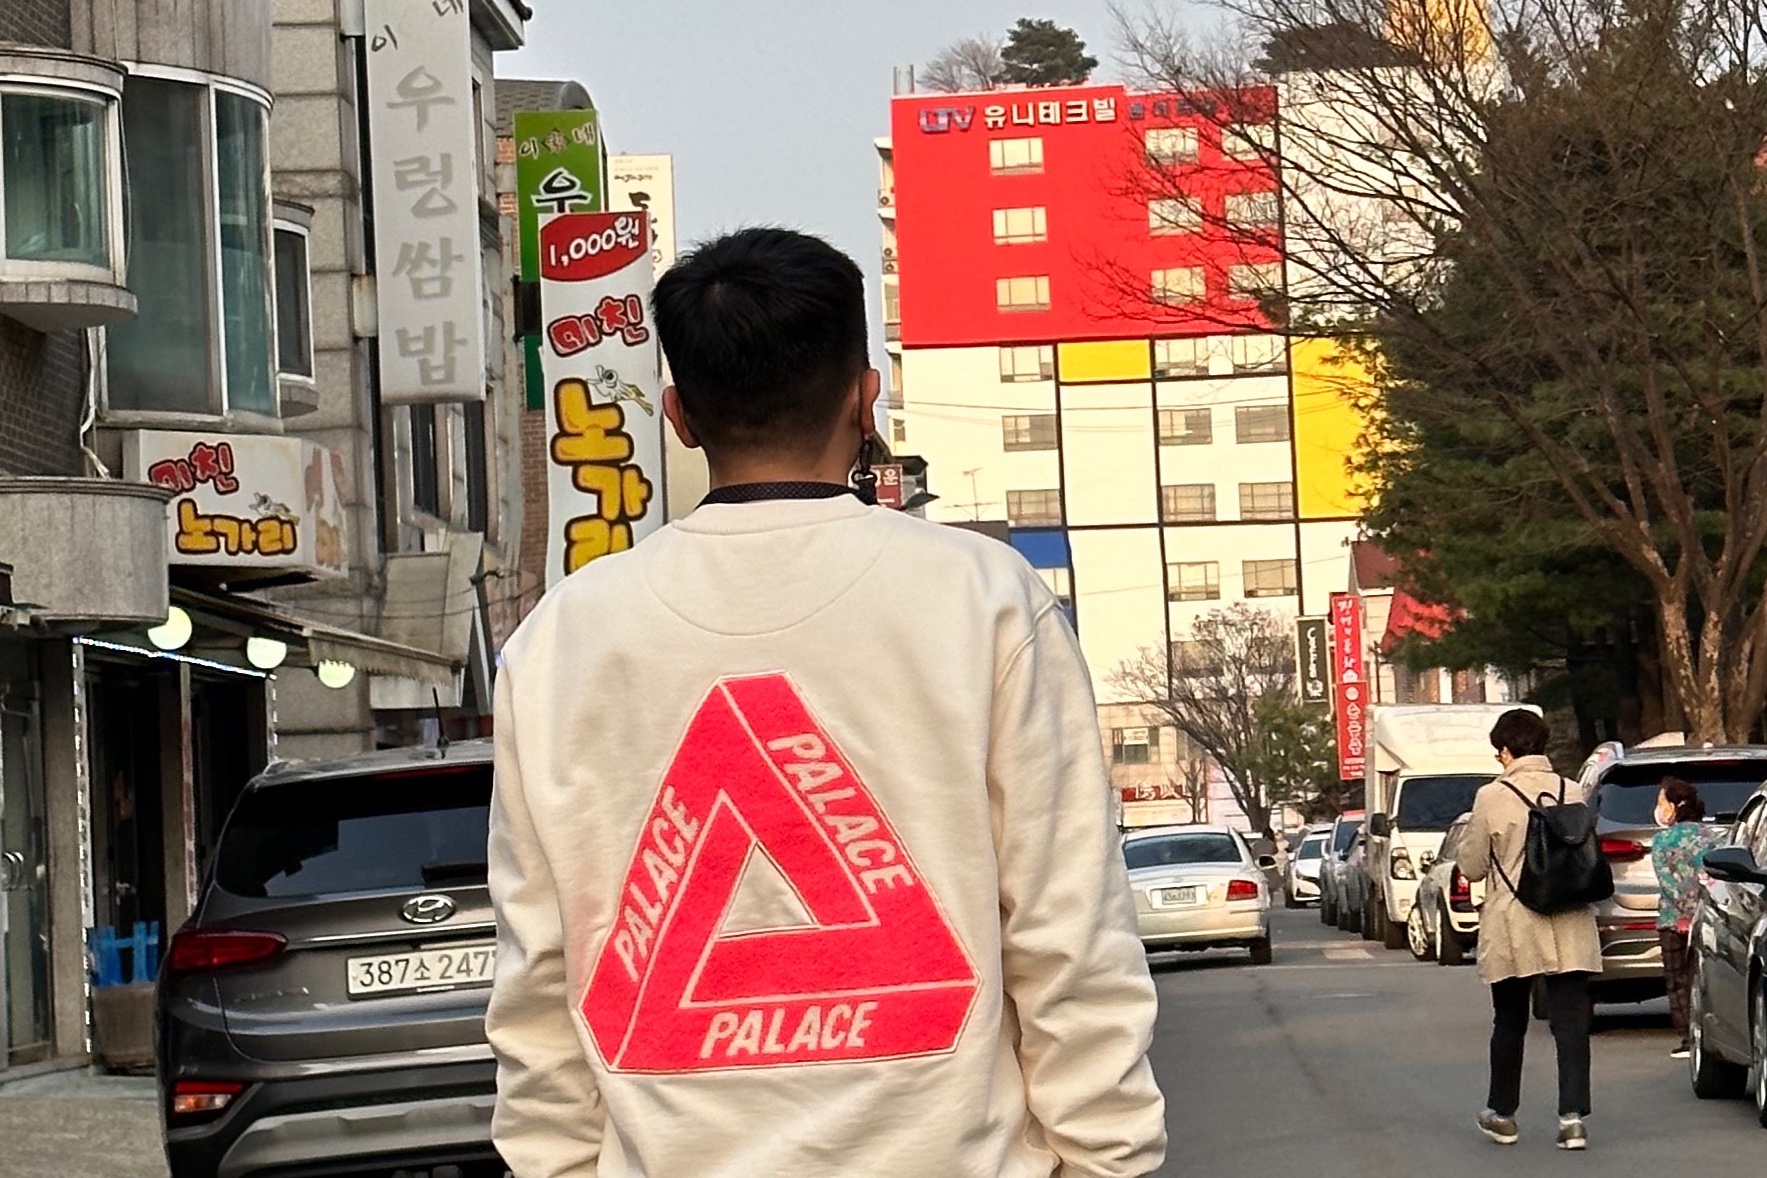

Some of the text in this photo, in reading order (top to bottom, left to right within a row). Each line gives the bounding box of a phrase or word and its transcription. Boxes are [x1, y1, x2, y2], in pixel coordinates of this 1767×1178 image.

[984, 97, 1117, 130] 유니테크빌
[386, 65, 468, 387] 우렁쌈밥
[550, 216, 641, 267] 1,000원
[547, 295, 649, 358] 미친
[148, 442, 239, 495] 미친
[175, 498, 298, 556] 노가리
[767, 732, 917, 894] PALACE
[612, 785, 702, 983] PALACE
[437, 950, 497, 981] 247
[700, 1002, 879, 1059] PALACE
